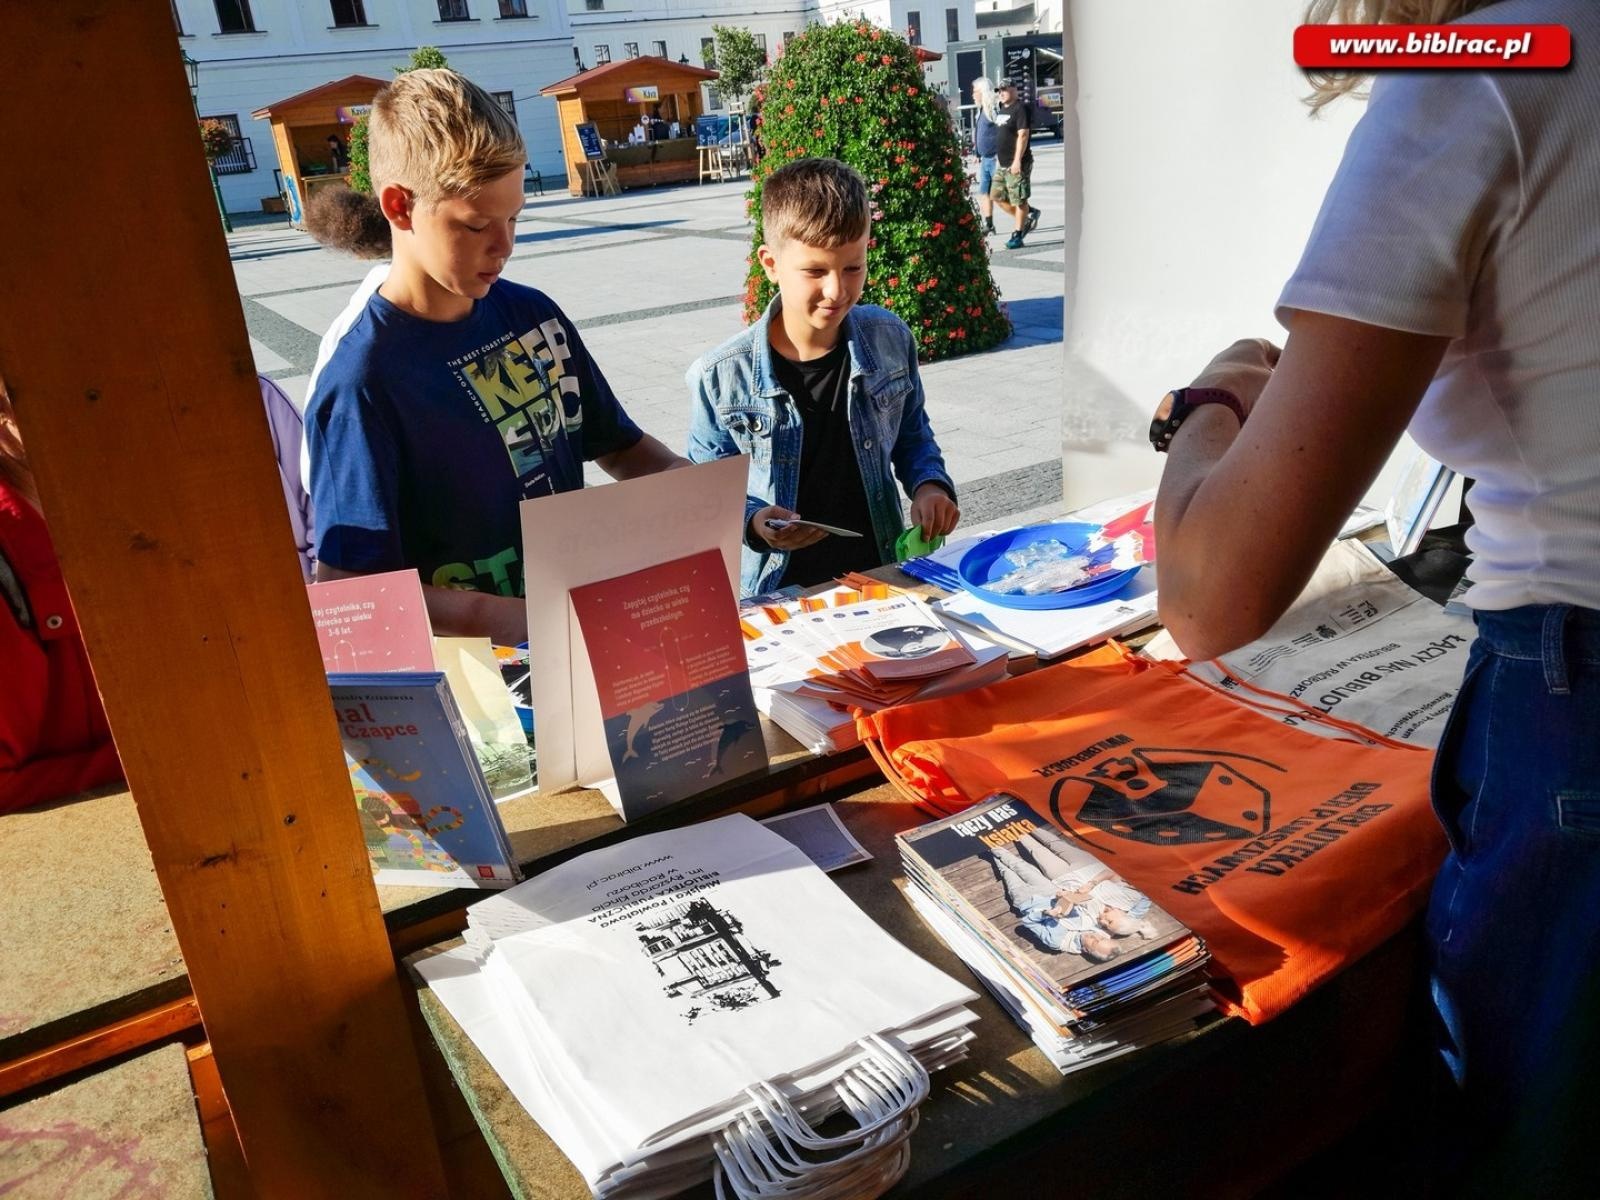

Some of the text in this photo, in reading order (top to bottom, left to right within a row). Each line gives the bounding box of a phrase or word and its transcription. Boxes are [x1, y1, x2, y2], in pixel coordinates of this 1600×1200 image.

[447, 358, 462, 367] THE
[463, 349, 480, 362] BEST
[481, 339, 501, 353] COAST
[461, 318, 571, 421] KEEP
[432, 546, 525, 597] ST
[351, 613, 373, 622] wieku
[362, 601, 375, 610] czy
[1411, 634, 1467, 663] ŁĄCZY
[1289, 643, 1401, 700] BIBLIOTEKA W RACIBORZ
[1375, 659, 1418, 674] NAS
[344, 722, 419, 740] Czapce
[950, 803, 1018, 837] łączy nas
[978, 819, 1036, 848] książka
[1245, 803, 1394, 876] BIBLIOTEKA
[586, 855, 673, 890] www.biblrac.pl
[606, 872, 666, 898] Raciborzu
[631, 874, 684, 897] Ryszarda
[587, 871, 720, 923] BIBLIOTEKA PUBLICZNA
[592, 894, 629, 912] Kincla
[676, 879, 721, 899] Miejska
[600, 898, 668, 928] Powiatowa
